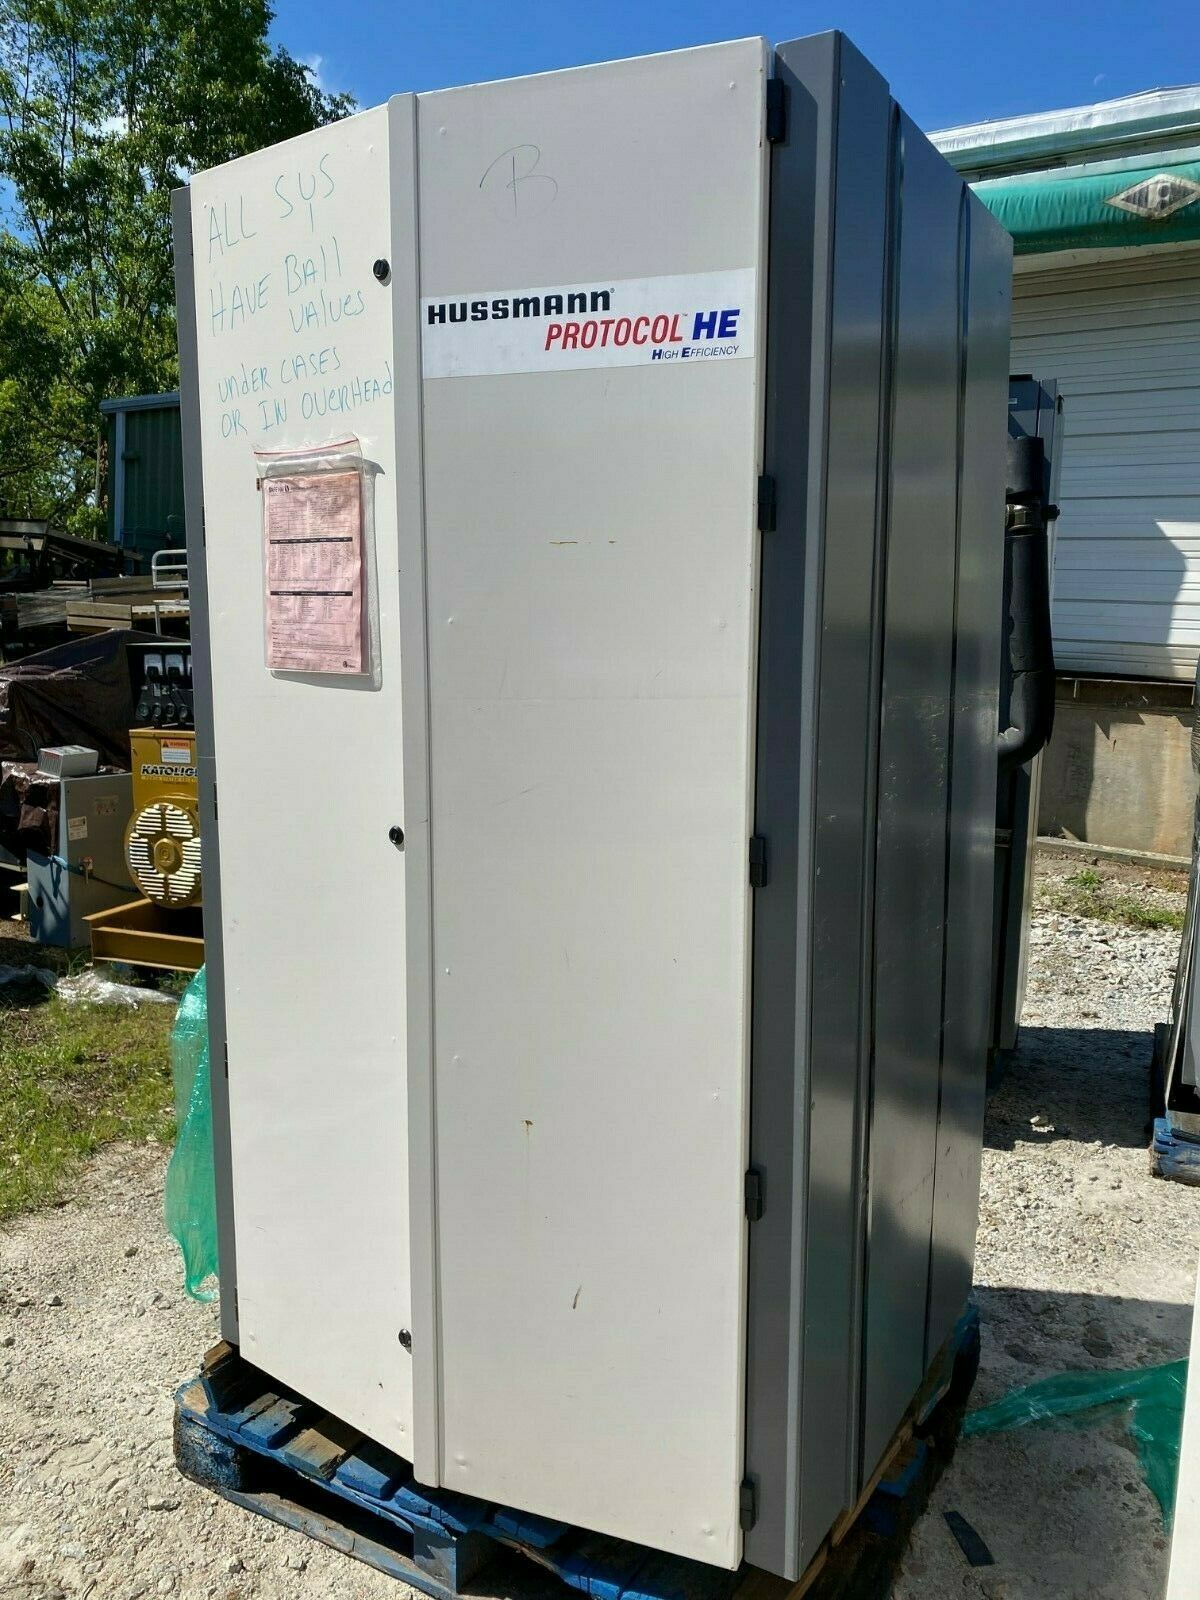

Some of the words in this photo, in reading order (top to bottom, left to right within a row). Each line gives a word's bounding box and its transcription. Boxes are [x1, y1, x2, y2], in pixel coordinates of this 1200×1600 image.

[208, 196, 257, 263] ALL
[274, 153, 335, 232] SYS
[209, 273, 272, 337] HAVE
[427, 289, 612, 325] HUSSMANN
[544, 313, 684, 351] PROTOCOL
[691, 308, 741, 341] HE
[280, 346, 341, 385] CASES
[651, 348, 679, 361] HIGH
[681, 345, 740, 358] EFFICIENCY
[221, 408, 248, 439] OR
[257, 398, 288, 431] IN
